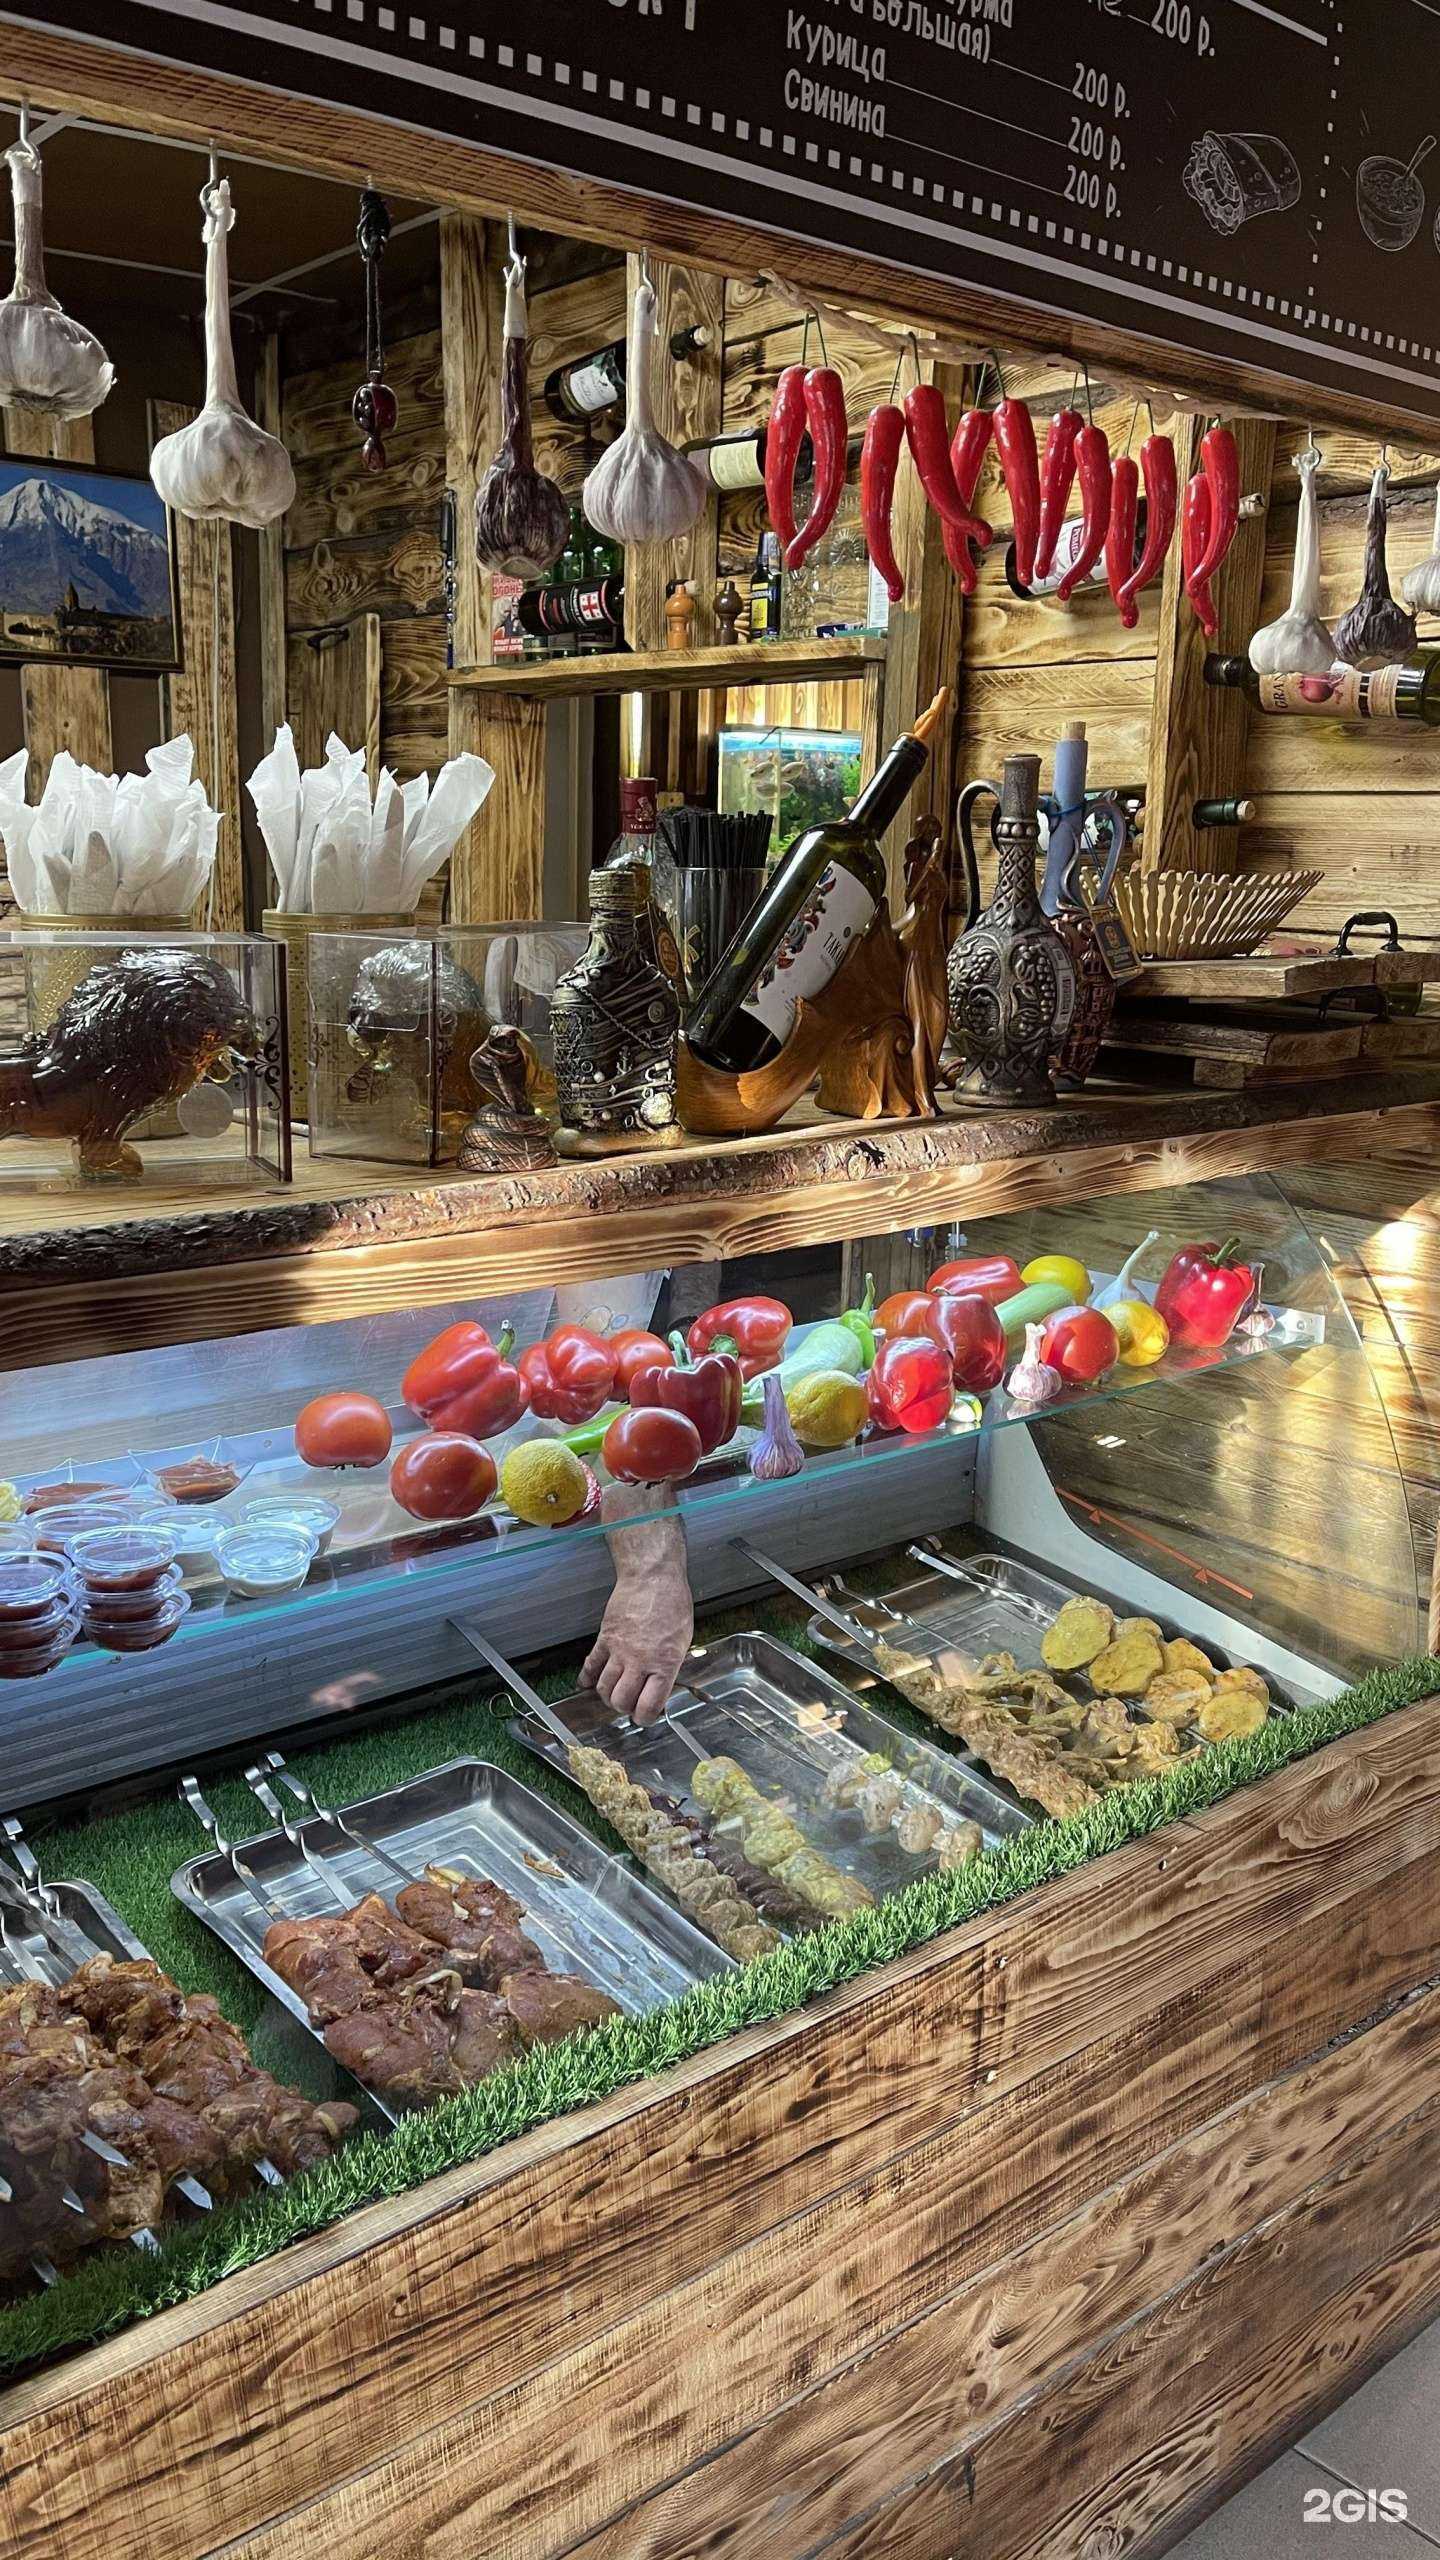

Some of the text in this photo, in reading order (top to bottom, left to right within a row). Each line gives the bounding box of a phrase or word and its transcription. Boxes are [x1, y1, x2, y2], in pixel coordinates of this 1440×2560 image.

[1150, 0, 1192, 44] 200
[786, 9, 1126, 171] Курица 200 р.
[1071, 62, 1109, 108] 200
[1114, 82, 1131, 119] р.
[784, 68, 1122, 219] Свинина 200 р.
